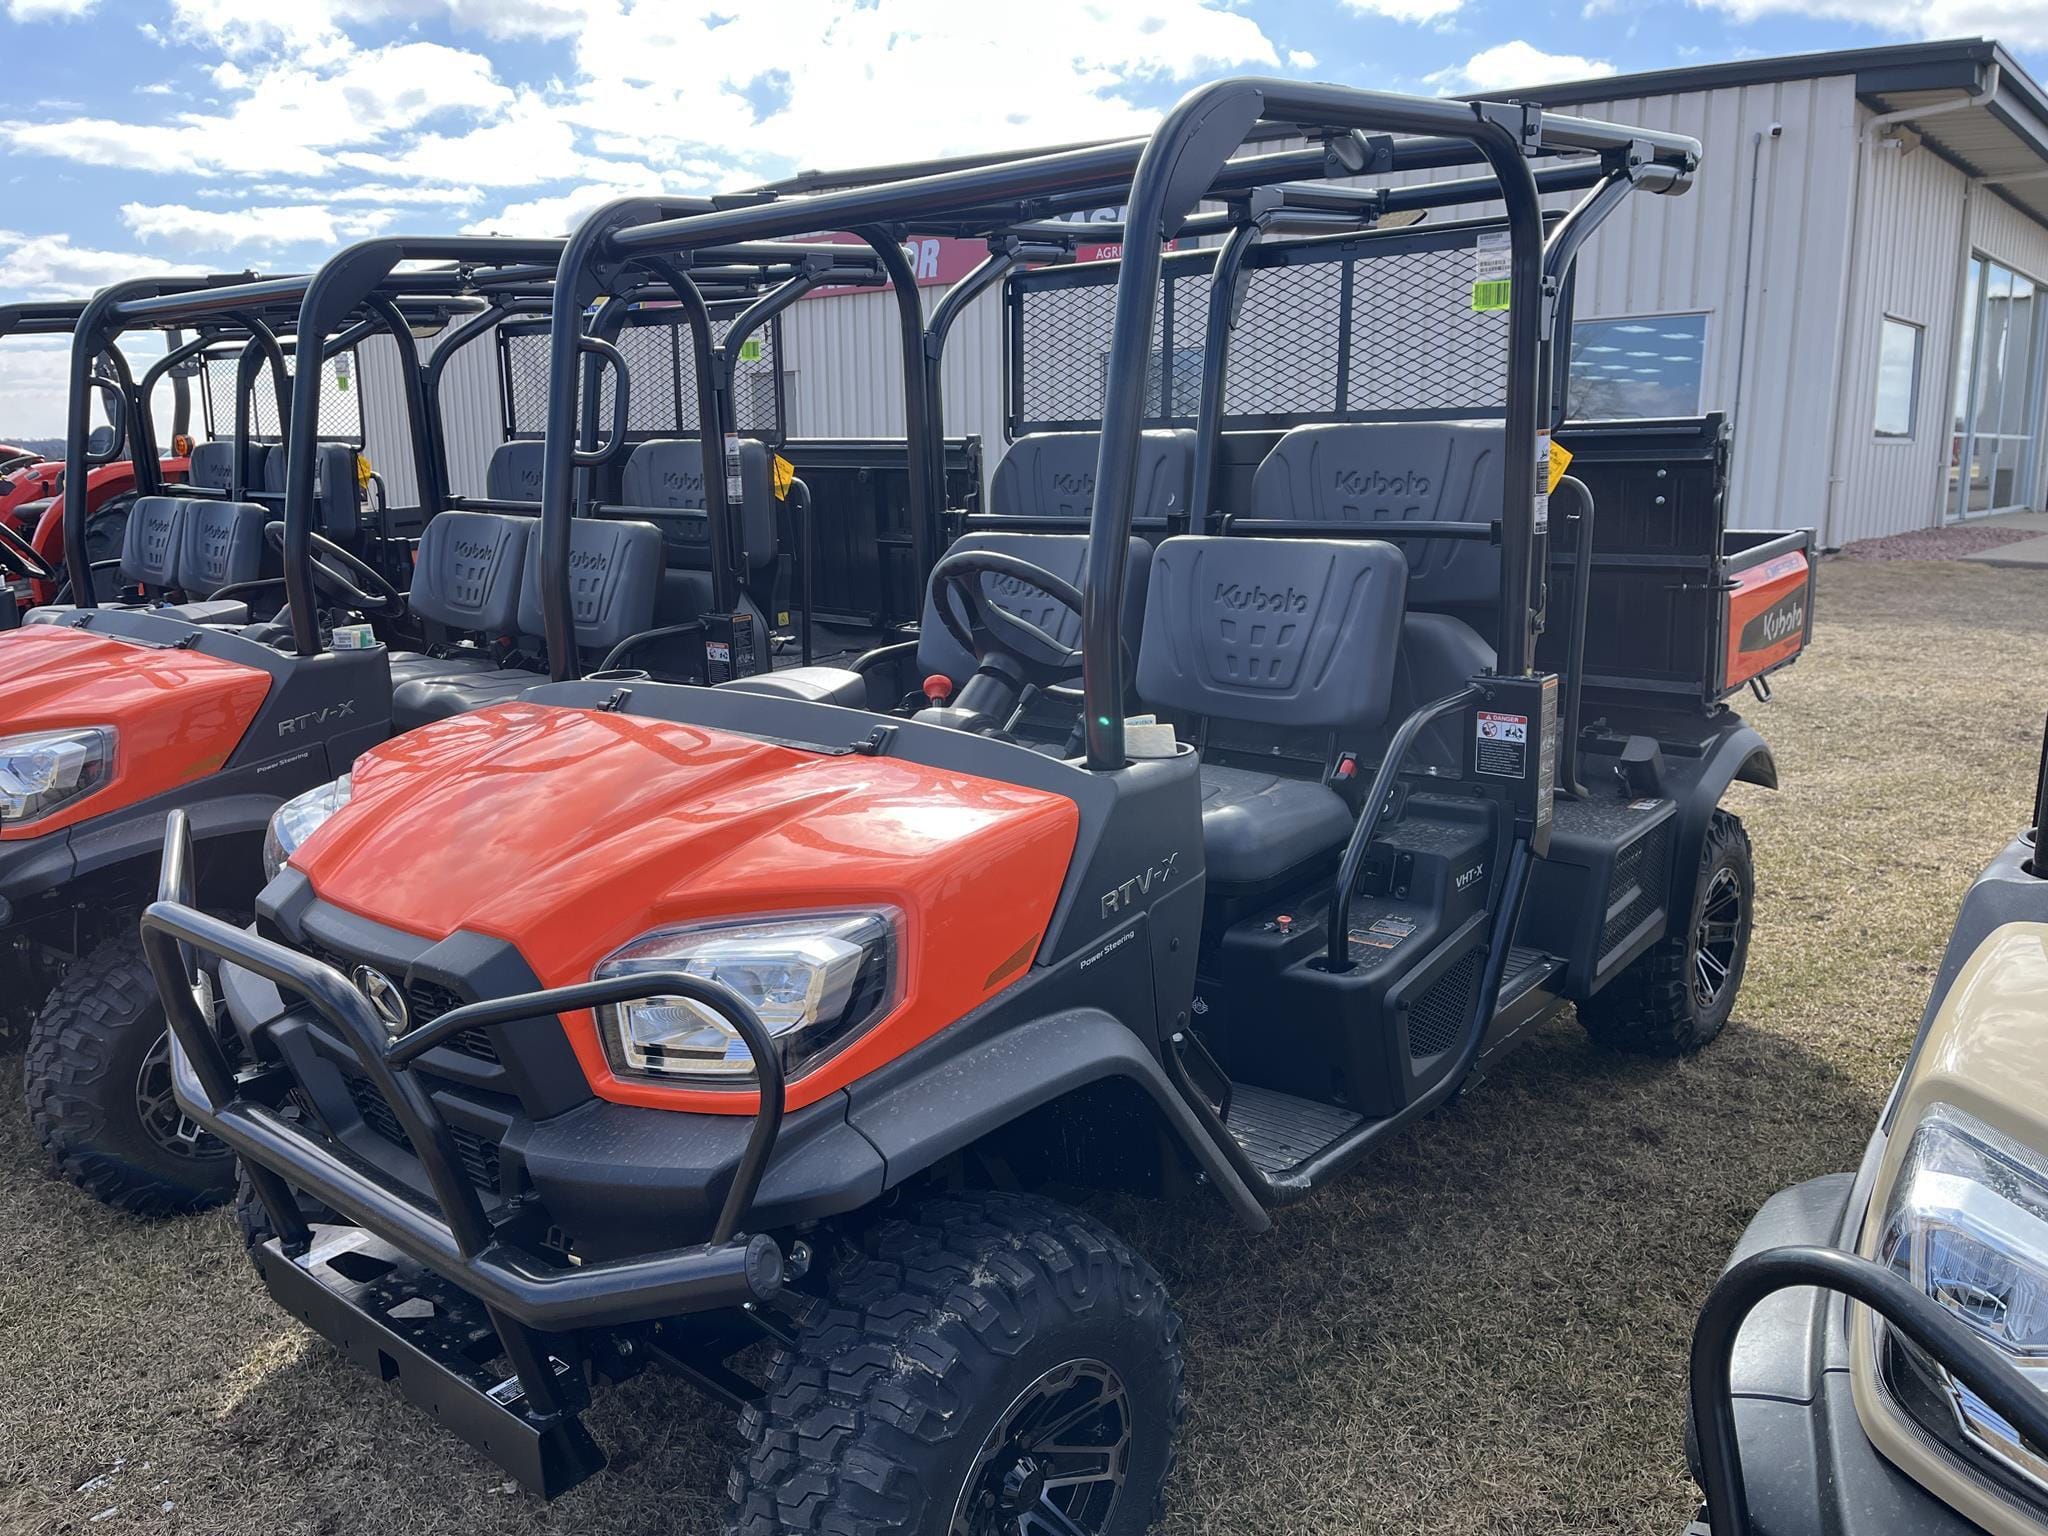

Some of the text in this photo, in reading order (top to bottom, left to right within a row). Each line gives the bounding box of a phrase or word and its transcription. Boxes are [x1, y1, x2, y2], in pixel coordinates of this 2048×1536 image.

[1335, 470, 1431, 497] Kubota
[1214, 583, 1309, 614] Kubota
[1763, 602, 1802, 641] Kubota
[278, 699, 355, 737] RTV-X
[1492, 715, 1519, 723] DANGER
[1100, 851, 1179, 920] RTV-X
[1455, 863, 1483, 888] VHT-X
[1080, 930, 1136, 970] Power Steering
